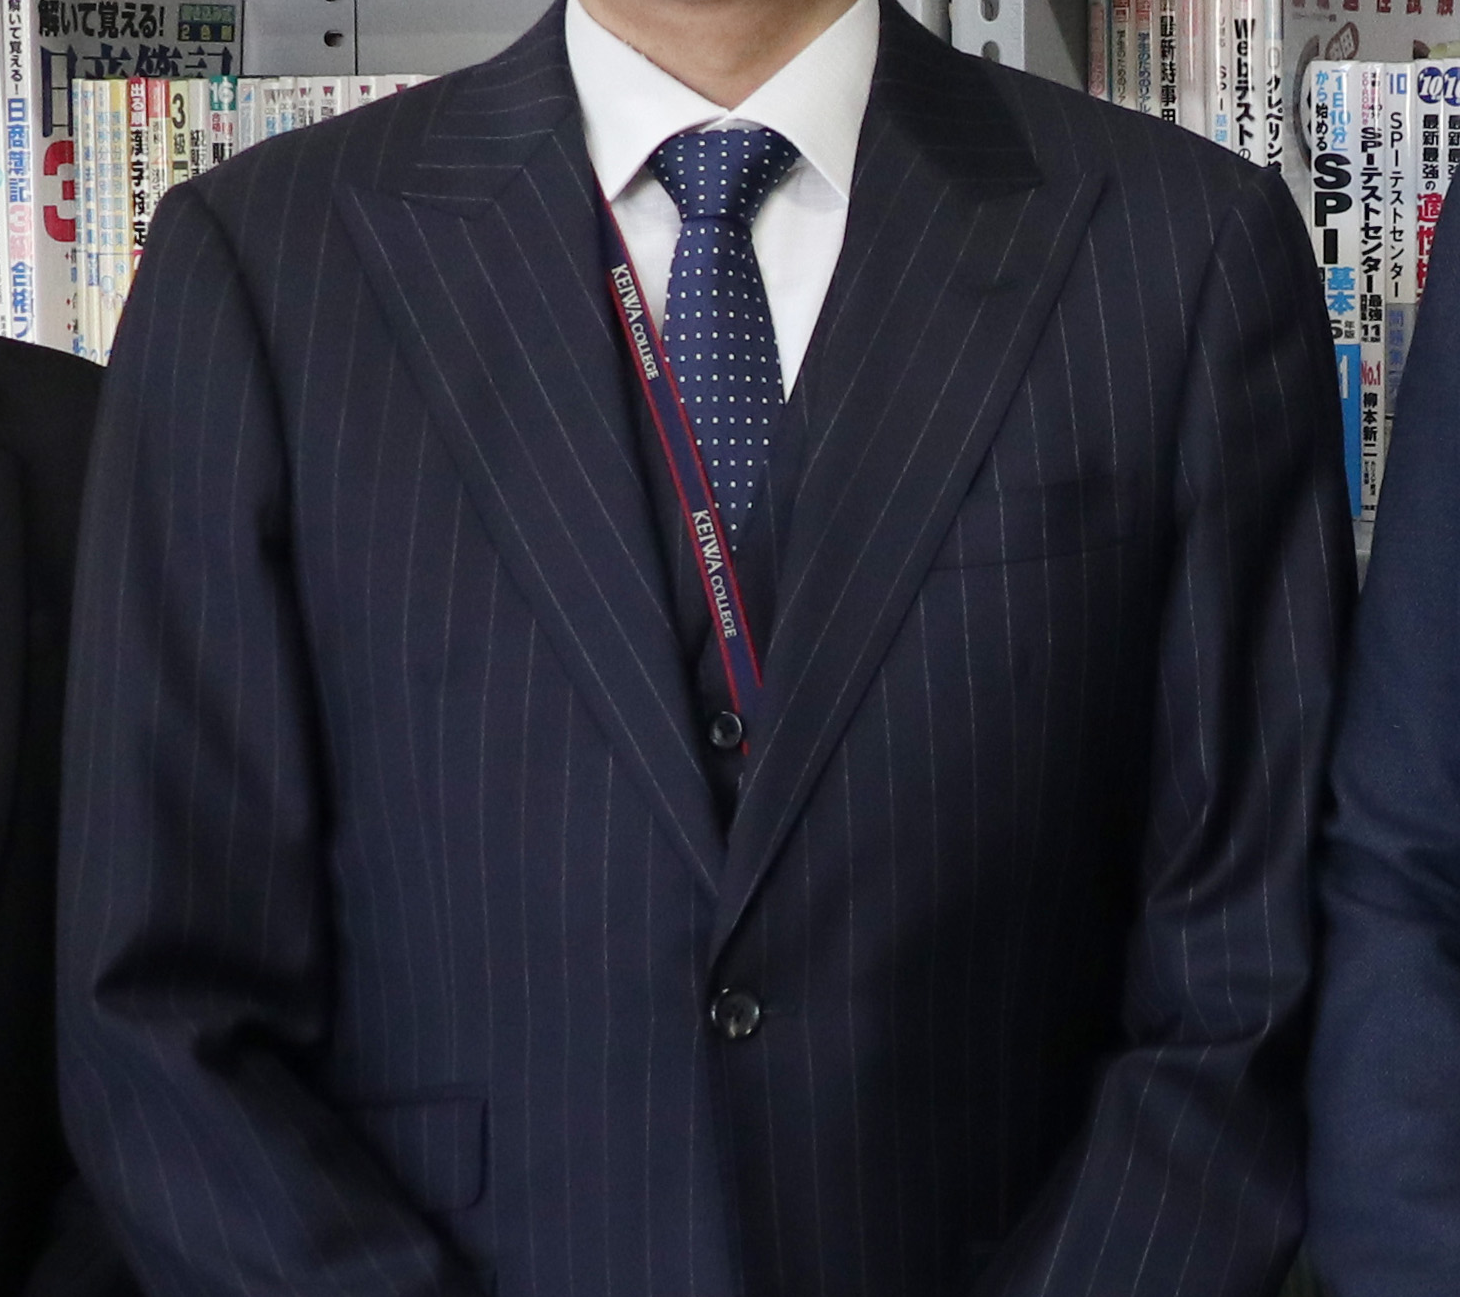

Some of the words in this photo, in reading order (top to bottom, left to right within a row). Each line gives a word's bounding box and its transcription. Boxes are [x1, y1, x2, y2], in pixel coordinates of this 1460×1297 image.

[8, 0, 23, 95] 解いて覚える!
[39, 0, 165, 39] 解いて覚える!
[1215, 113, 1228, 143] 基礎
[1234, 18, 1257, 162] Webテストの
[1314, 70, 1330, 151] から始める
[8, 98, 31, 202] 日商簿記
[1422, 114, 1440, 192] 最新最強の
[1313, 153, 1354, 264] SPI
[1360, 126, 1385, 294] SPIテストセンター
[1389, 112, 1405, 299] SPIテストセンター
[611, 262, 644, 323] KEIWA
[630, 321, 659, 381] COLLEGE
[1327, 267, 1356, 315] 基本
[1361, 359, 1382, 387] No.1
[1362, 392, 1379, 458] 柳本新二
[691, 508, 723, 575] KEIWA
[710, 573, 738, 639] COLLEGE
